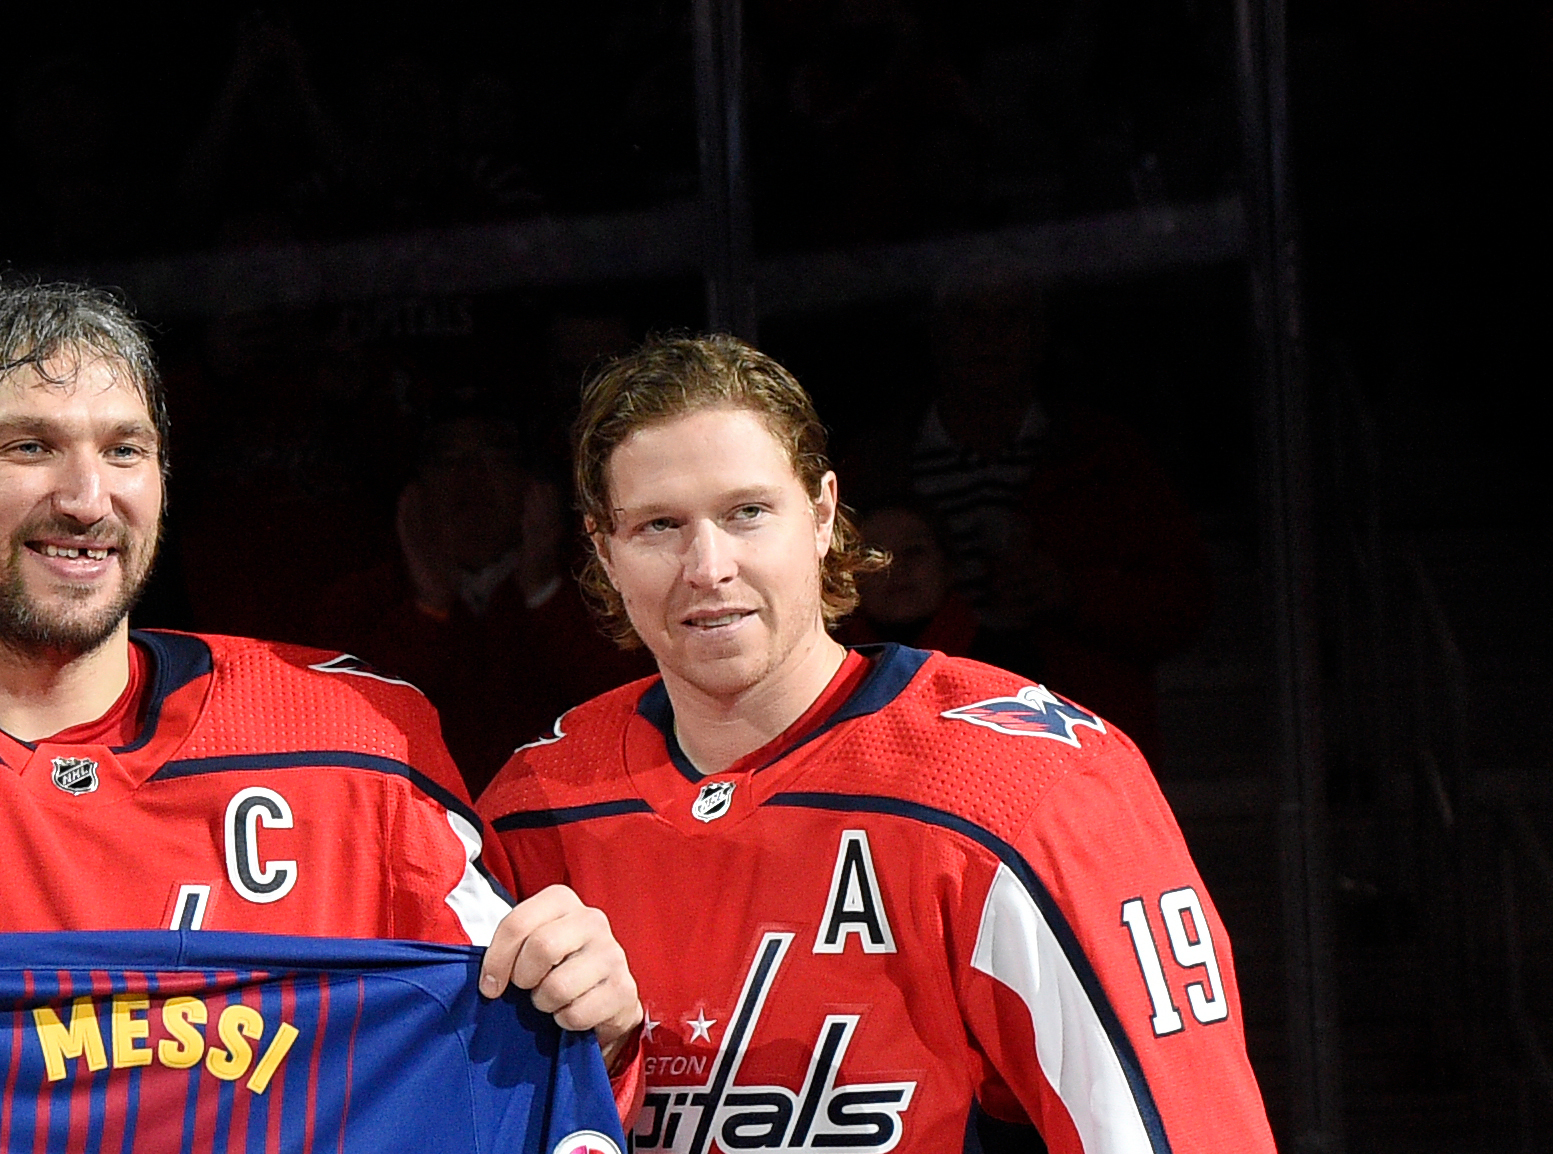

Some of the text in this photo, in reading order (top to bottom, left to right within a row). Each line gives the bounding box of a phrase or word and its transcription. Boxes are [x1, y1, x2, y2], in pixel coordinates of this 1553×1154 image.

[224, 786, 298, 903] C
[813, 829, 898, 954] A
[1120, 885, 1229, 1038] 19
[32, 994, 299, 1094] MESSI
